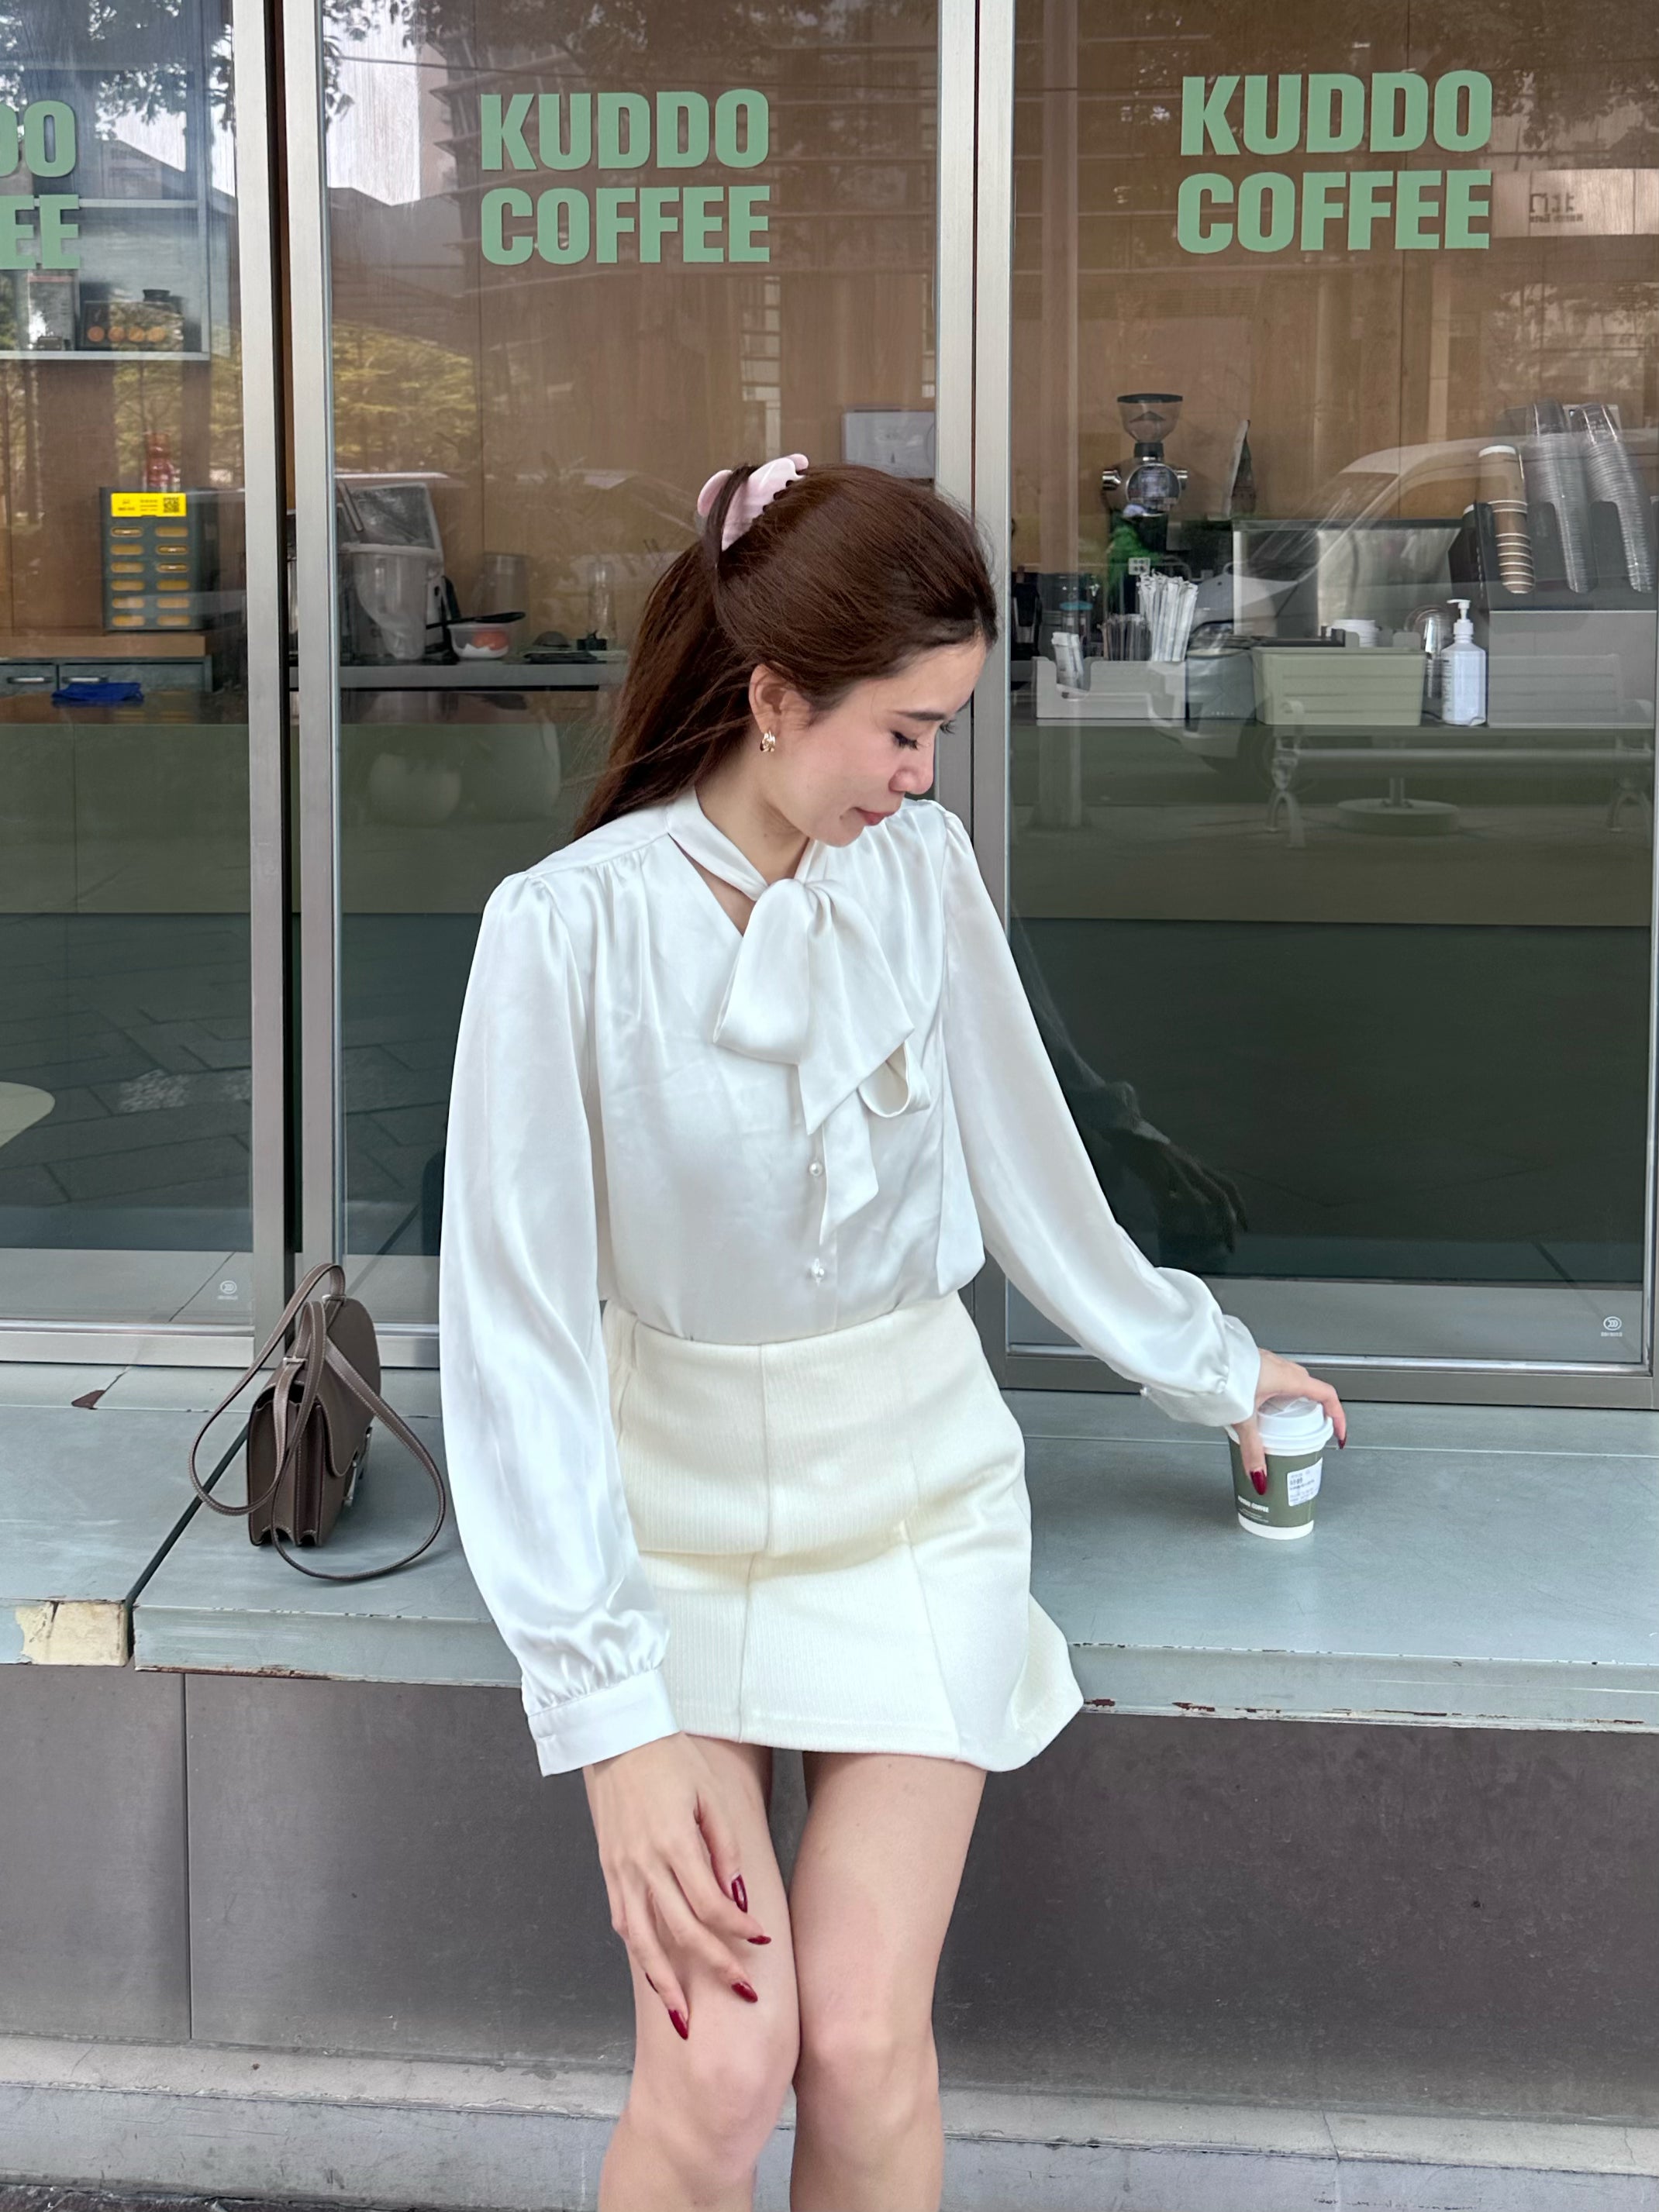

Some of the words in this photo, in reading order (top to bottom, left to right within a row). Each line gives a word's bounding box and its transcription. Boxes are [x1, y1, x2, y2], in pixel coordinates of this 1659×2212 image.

[481, 88, 769, 171] KUDDO
[1181, 70, 1493, 156] KUDDO
[481, 185, 770, 265] COFFEE
[1178, 169, 1492, 253] COFFEE
